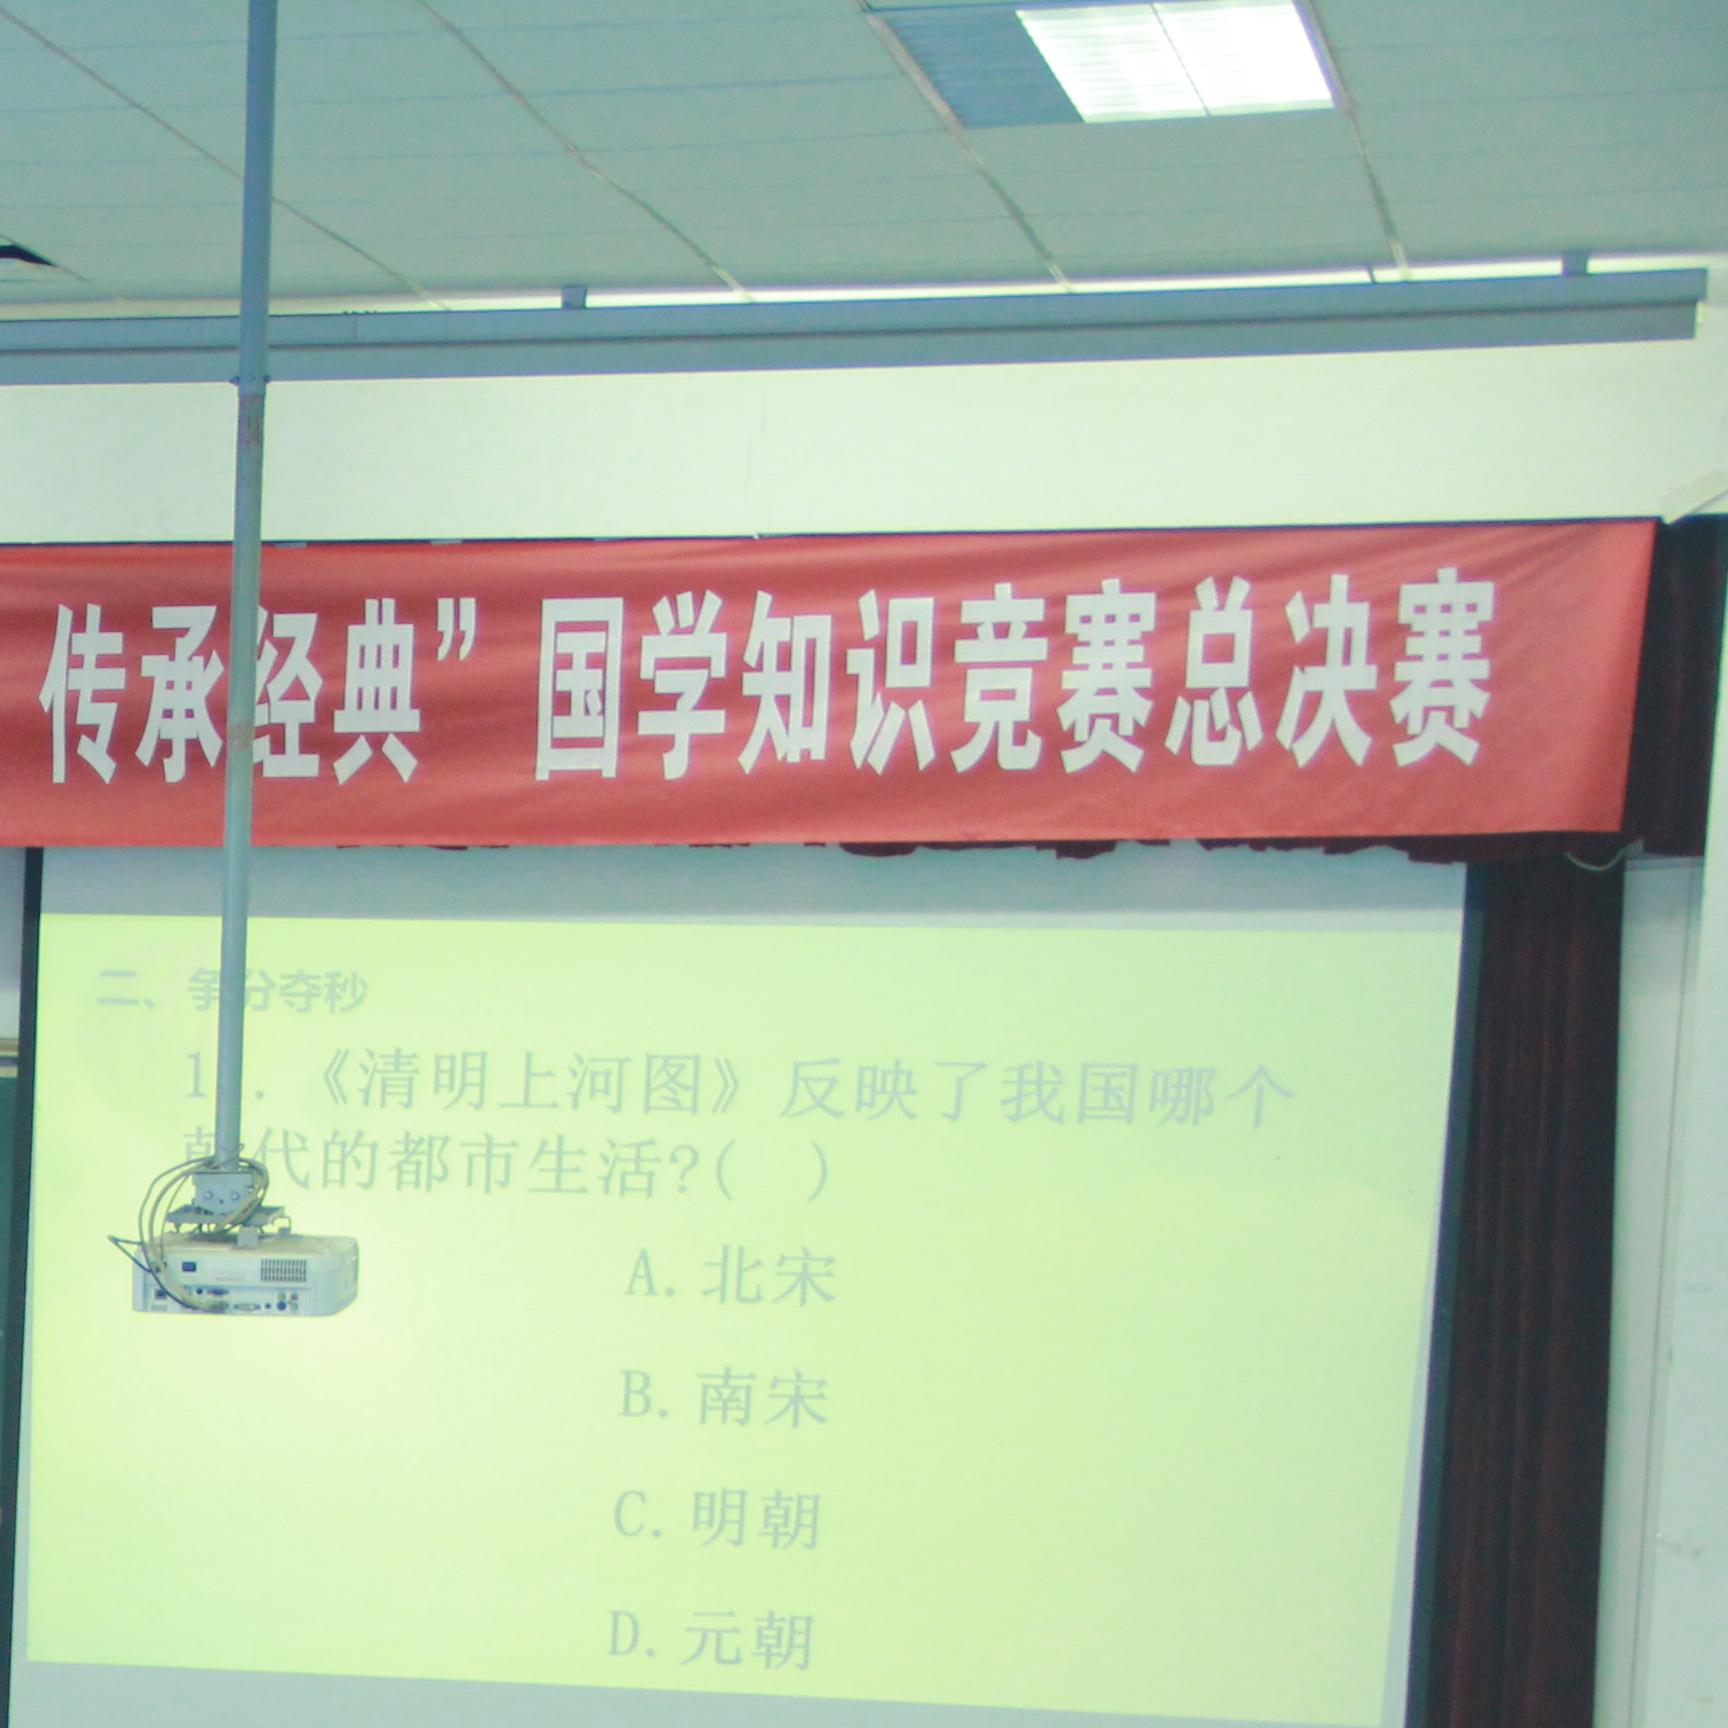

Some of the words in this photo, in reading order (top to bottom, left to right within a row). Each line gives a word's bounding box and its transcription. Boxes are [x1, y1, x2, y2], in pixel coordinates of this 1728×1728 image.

[184, 1046, 1297, 1130] 1.《清明上河图》反映了我国哪个
[624, 1244, 837, 1307] A.北宋
[618, 1366, 829, 1429] B.南宋
[613, 1489, 821, 1551] C.明朝
[607, 1610, 814, 1670] D.元朝
